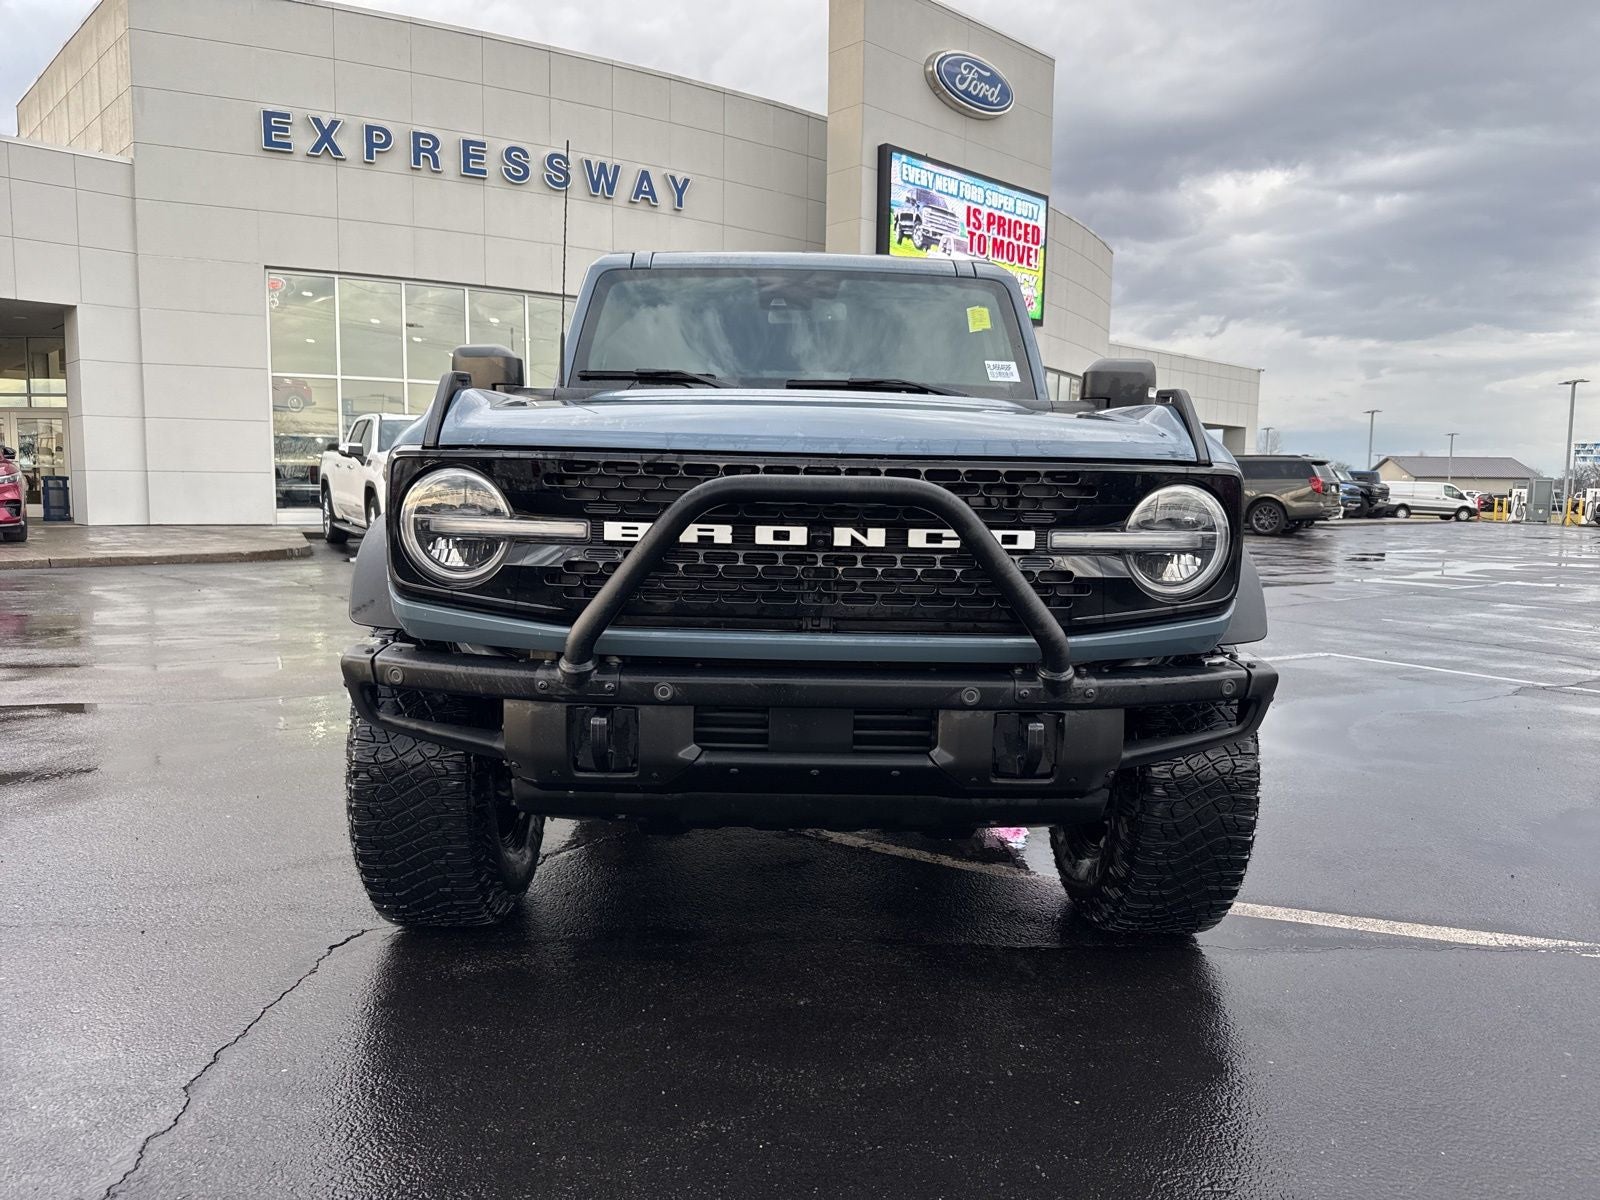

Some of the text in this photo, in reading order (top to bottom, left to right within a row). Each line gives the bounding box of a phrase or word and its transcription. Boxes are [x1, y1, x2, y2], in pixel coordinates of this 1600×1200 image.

[955, 61, 1002, 104] Ford
[259, 107, 693, 211] EXPRESSWAY
[902, 163, 1040, 221] EVERY NEW FORD SUPER DUTY
[966, 205, 1041, 246] IS PRICED
[967, 231, 1039, 269] TO MOVE!
[603, 521, 1036, 550] BRONCO
